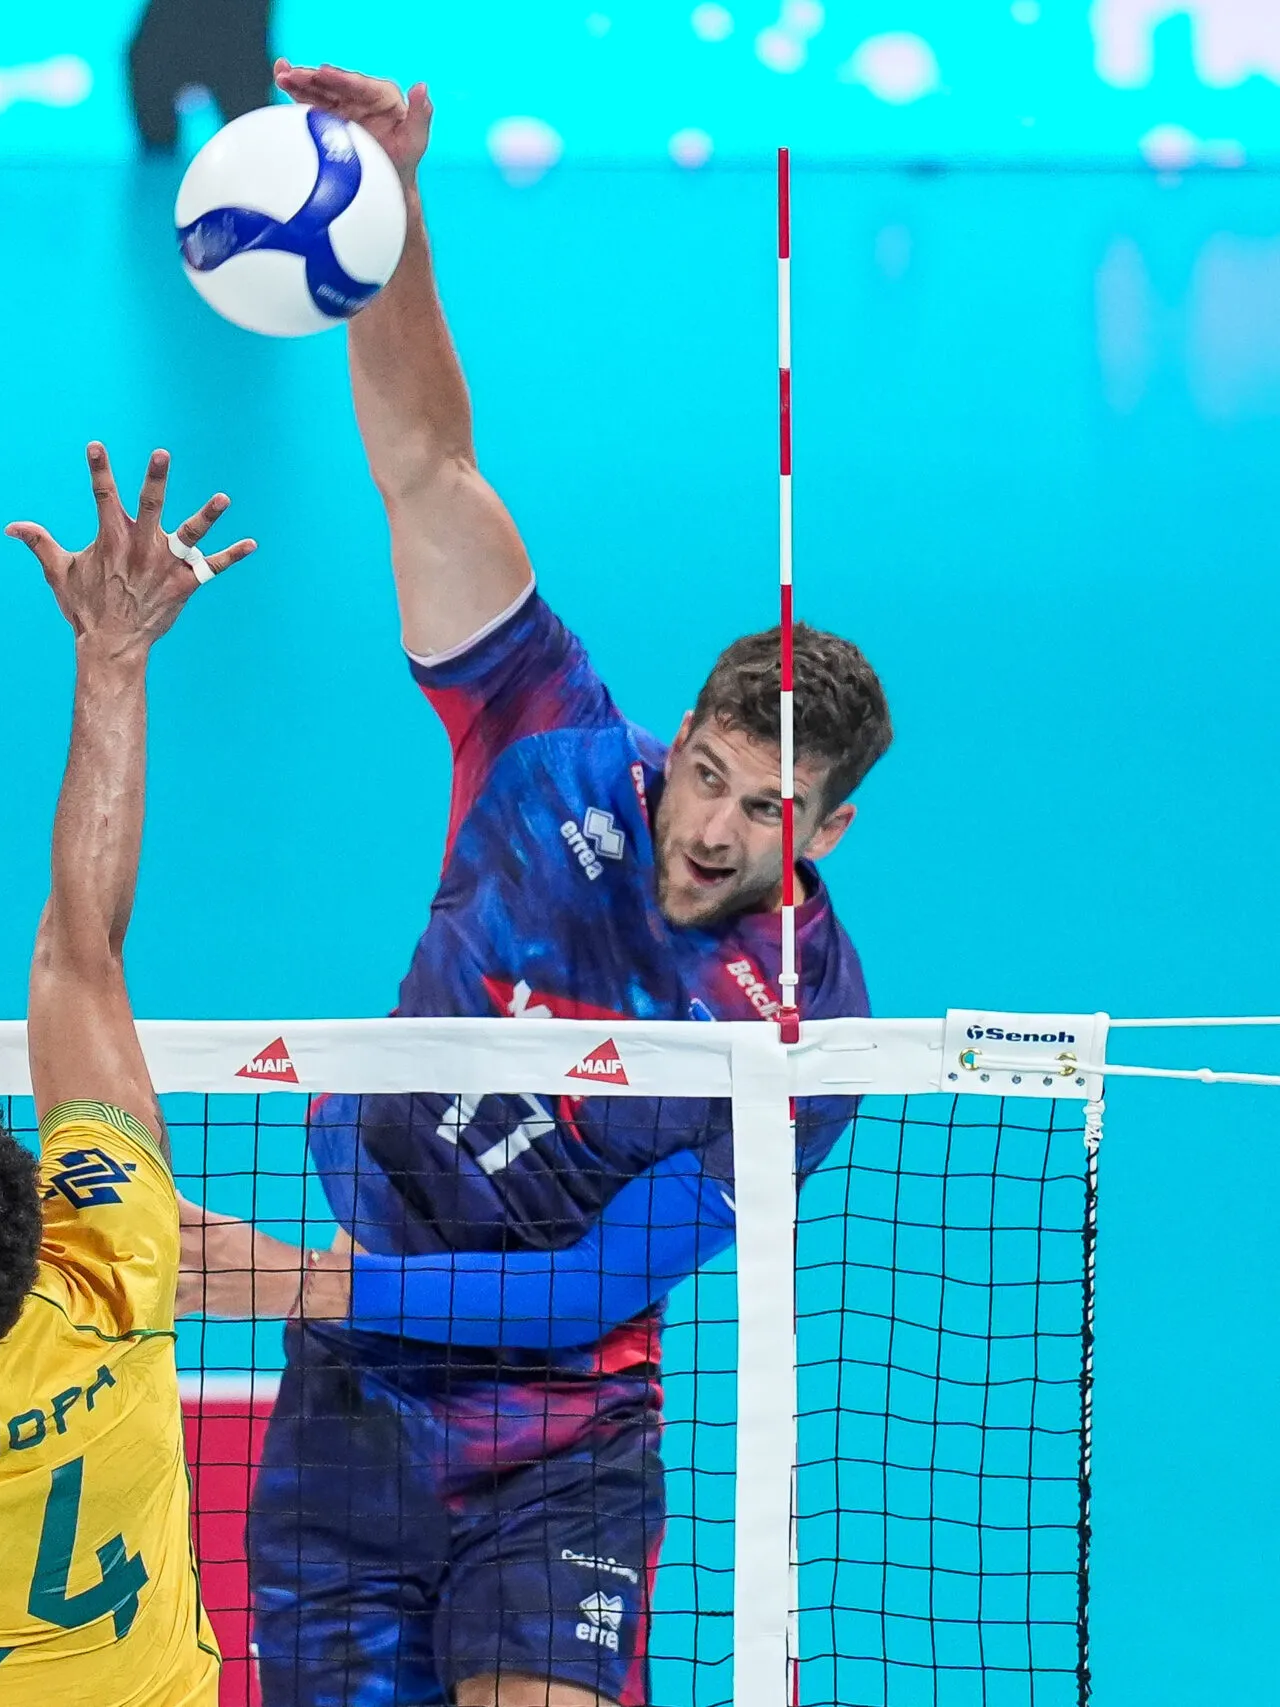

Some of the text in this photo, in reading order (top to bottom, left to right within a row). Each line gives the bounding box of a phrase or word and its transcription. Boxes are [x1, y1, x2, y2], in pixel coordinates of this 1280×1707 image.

[985, 1027, 1075, 1043] Senoh
[246, 1058, 292, 1073] MAIF
[576, 1059, 622, 1074] MAIF
[575, 1622, 619, 1652] erre
